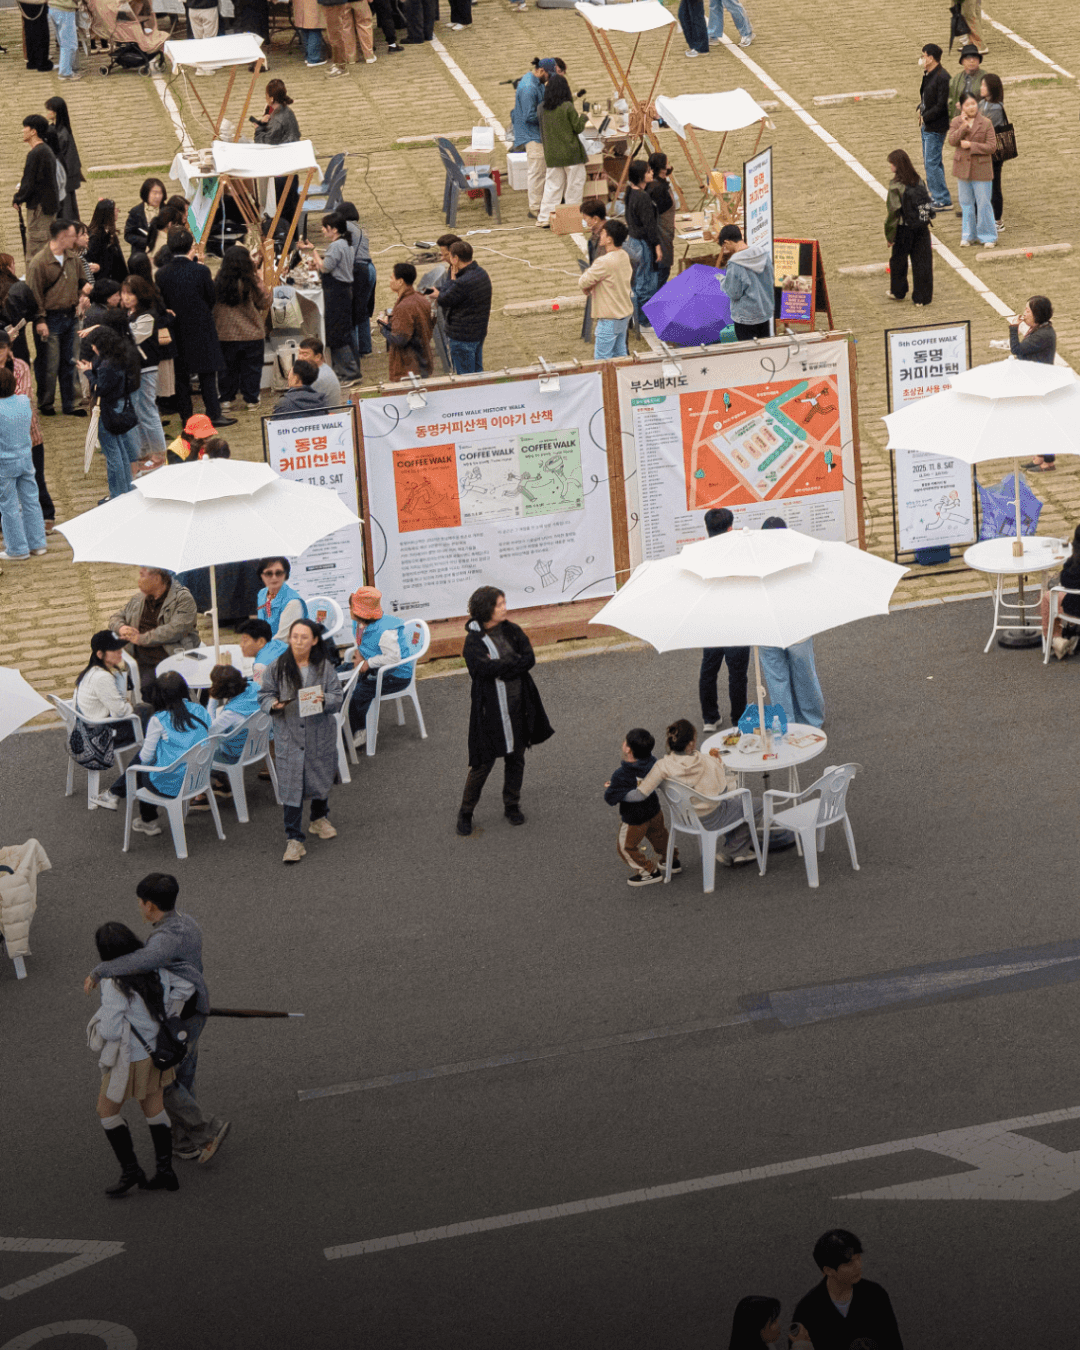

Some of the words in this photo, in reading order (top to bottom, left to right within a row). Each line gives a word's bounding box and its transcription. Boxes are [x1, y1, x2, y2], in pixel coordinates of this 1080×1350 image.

[911, 337, 938, 347] COFFEE
[938, 334, 958, 343] WALK
[913, 348, 943, 364] 동명
[899, 362, 960, 382] 커피산책
[630, 375, 689, 394] 부스배치도
[902, 385, 925, 397] 초상권
[926, 384, 941, 394] 사용
[441, 411, 464, 419] COFFEE
[464, 409, 482, 417] WALK
[482, 406, 508, 414] HISTORY
[507, 404, 526, 412] WALK
[277, 428, 291, 436] 5th
[291, 425, 321, 434] COFFEE
[321, 421, 343, 430] WALK
[415, 417, 488, 438] 동명커피산책
[490, 413, 527, 429] 이야기
[529, 409, 554, 423] 산책
[294, 435, 328, 453] 동명
[520, 442, 553, 454] COFFEE
[553, 439, 577, 449] WALK
[279, 450, 347, 472] 커피산책
[396, 458, 428, 468] COFFEE
[429, 455, 452, 465] WALK
[459, 450, 491, 461] COFFEE
[491, 447, 515, 457] WALK
[329, 473, 344, 485] SAT
